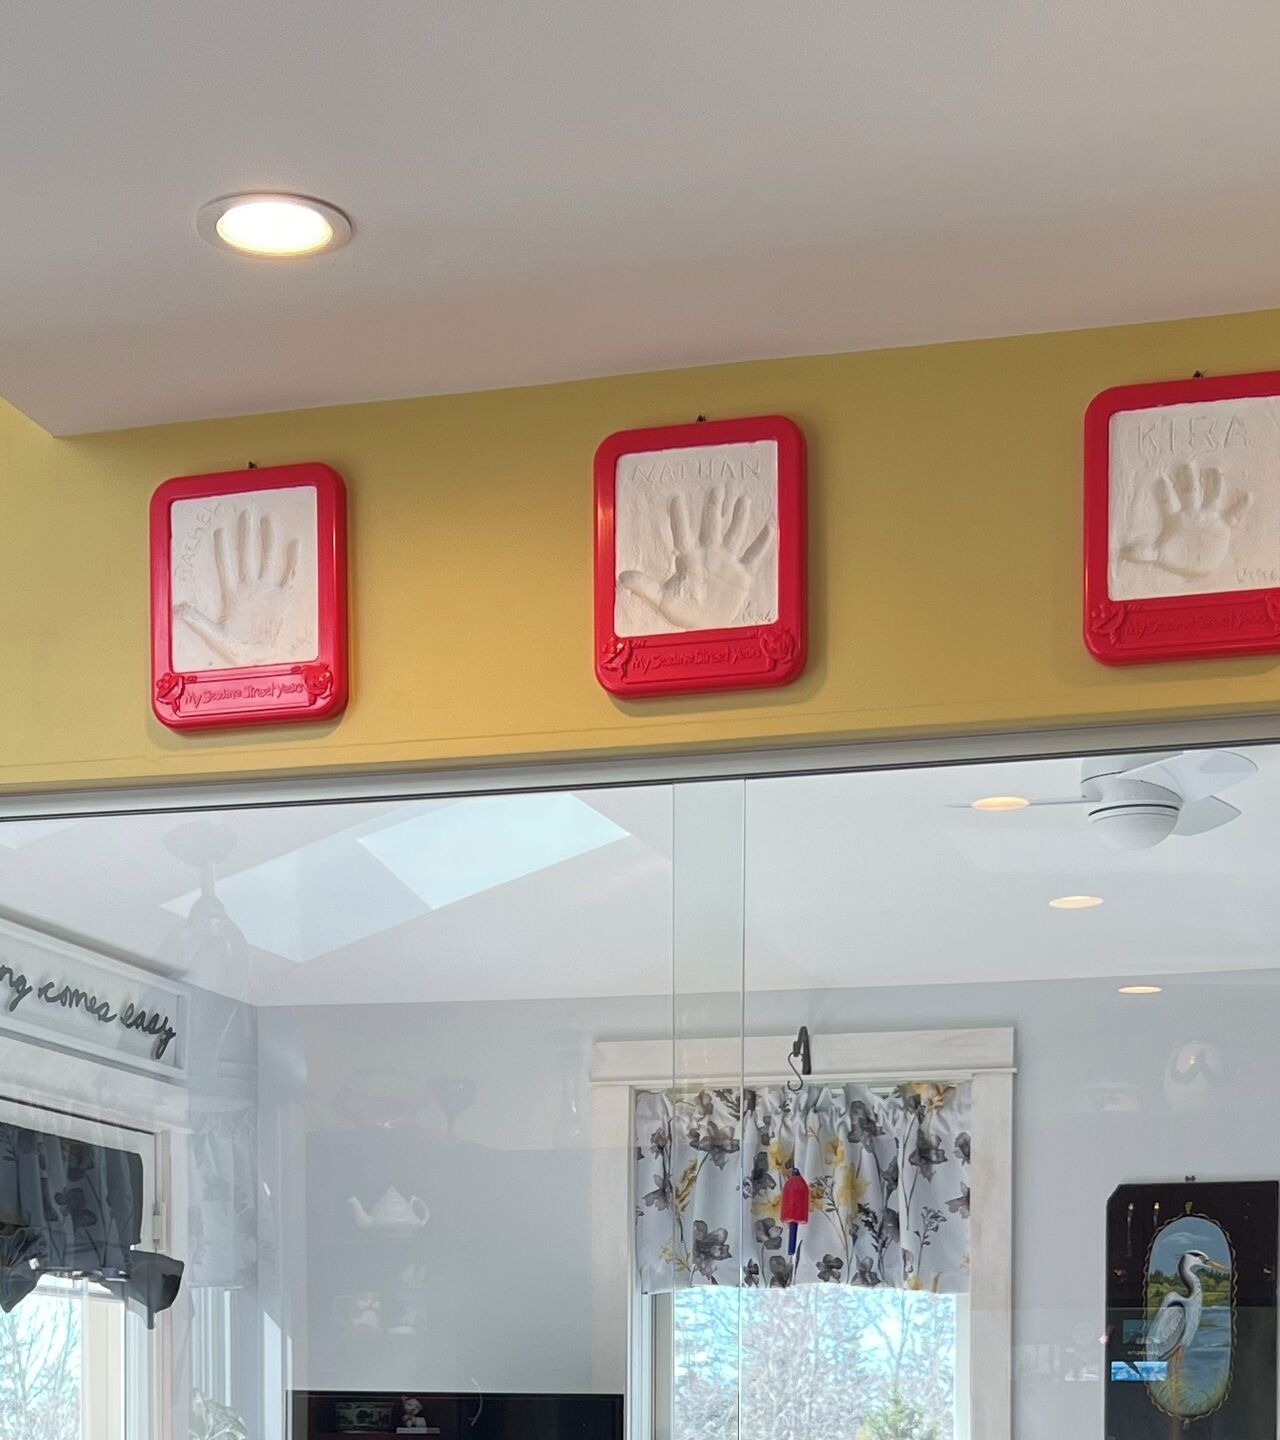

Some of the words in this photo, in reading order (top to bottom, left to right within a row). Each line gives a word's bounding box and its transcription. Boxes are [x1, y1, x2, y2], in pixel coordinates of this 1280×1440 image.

[1137, 414, 1249, 456] KIRA
[631, 654, 651, 675] My
[185, 691, 203, 709] My
[37, 981, 118, 1024] comes
[119, 1003, 177, 1060] easy
